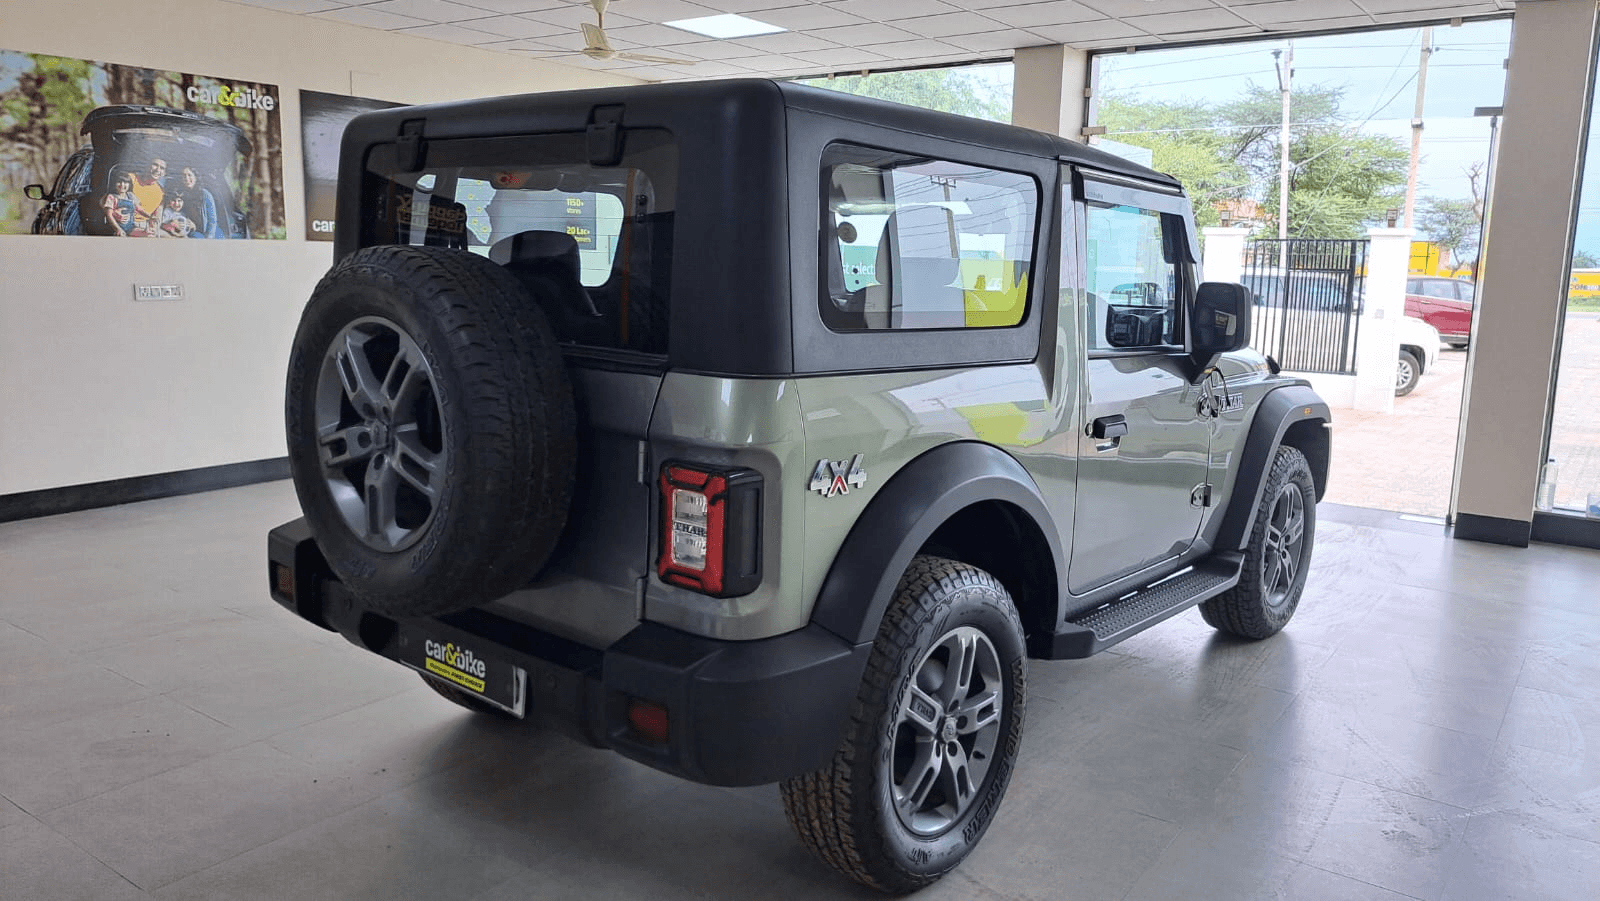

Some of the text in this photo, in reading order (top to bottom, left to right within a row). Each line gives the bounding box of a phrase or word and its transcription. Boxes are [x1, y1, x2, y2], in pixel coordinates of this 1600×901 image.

[186, 85, 274, 111] car&bike
[312, 219, 335, 232] car
[674, 521, 707, 537] THAR
[425, 639, 486, 679] car&bike
